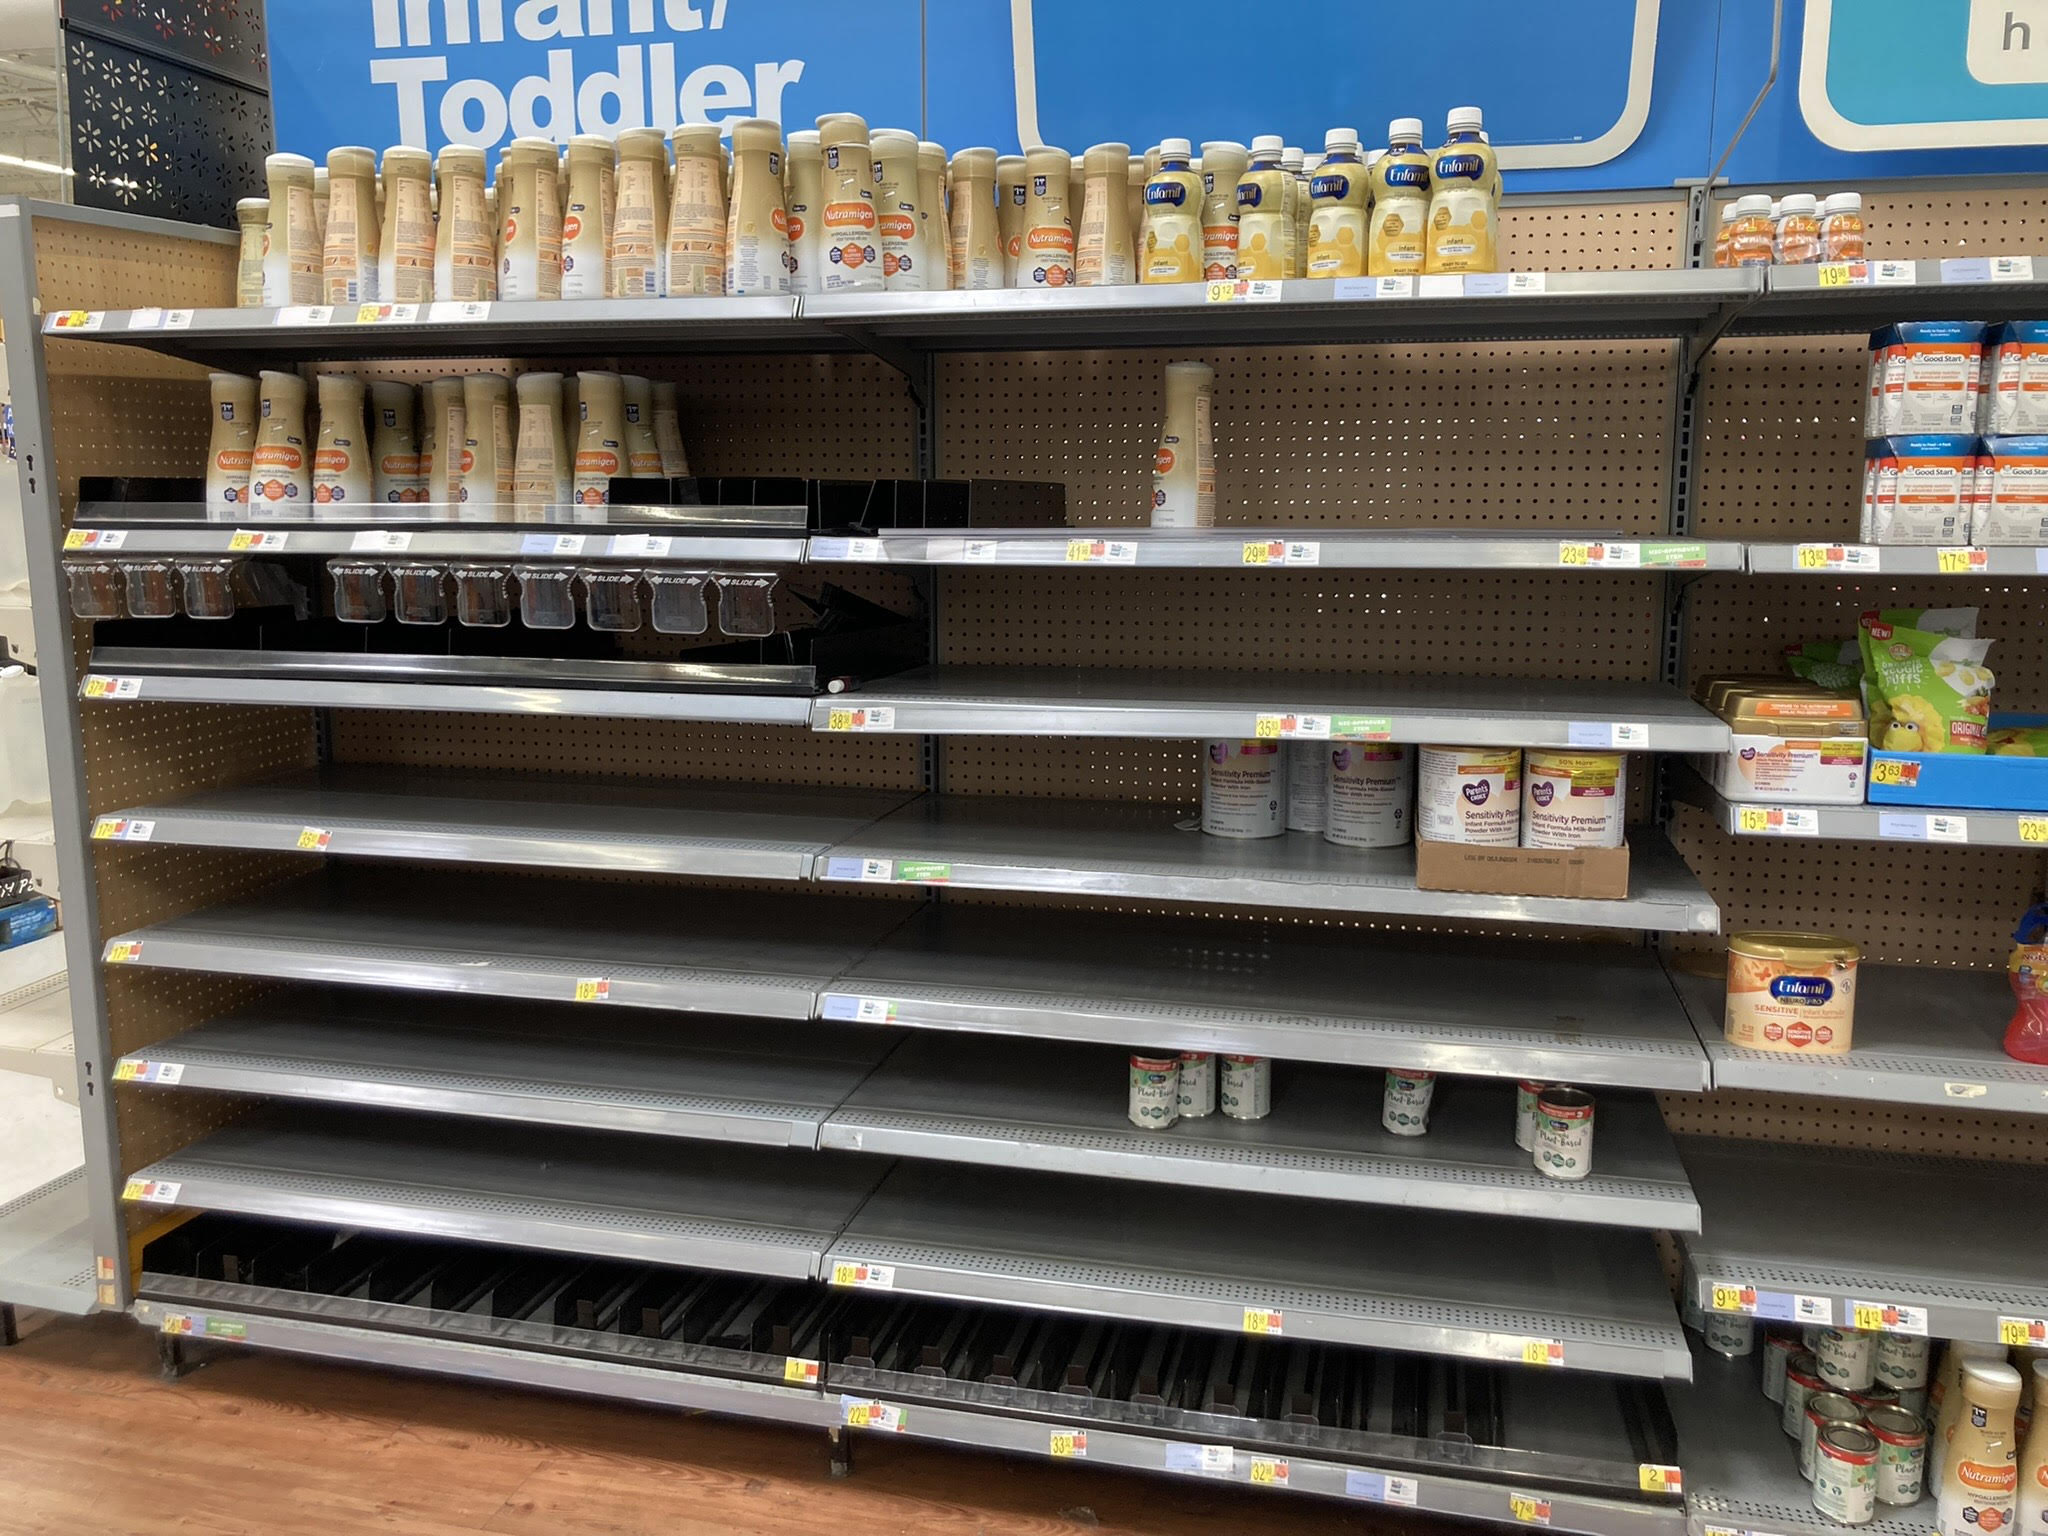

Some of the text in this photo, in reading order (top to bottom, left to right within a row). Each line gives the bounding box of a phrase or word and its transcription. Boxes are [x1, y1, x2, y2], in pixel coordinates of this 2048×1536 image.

[370, 42, 806, 151] Toddler
[1438, 159, 1479, 173] Enfamil
[1311, 179, 1343, 194] Enfamil
[1147, 187, 1182, 200] Enfamil
[825, 208, 874, 222] Nutramigen
[1923, 355, 1943, 363] Good
[1944, 354, 1962, 363] Start
[219, 454, 252, 466] Nutram
[1914, 468, 1953, 476] Good Start
[2012, 468, 2048, 476] Good Star
[190, 565, 211, 573] SLIDE
[343, 567, 363, 575] SLIDE
[404, 568, 426, 576] SLIDE
[531, 573, 554, 581] SLIDE
[597, 575, 621, 583] SLIDE
[663, 577, 688, 585] SLIDE
[731, 578, 756, 586] SLIDE
[1871, 627, 1892, 638] NEW!
[1951, 721, 1982, 736] ORIGINAL
[1756, 751, 1787, 760] Sensitivity
[1558, 758, 1574, 766] 50%
[1211, 768, 1242, 778] Sensitivity
[1887, 767, 1900, 776] 63
[1333, 774, 1364, 785] Sensitivity
[1465, 784, 1489, 797] Parent's
[1465, 810, 1504, 820] Sensitivity
[1532, 810, 1568, 825] Sensitivity
[1547, 824, 1571, 832] Formula
[1552, 830, 1567, 838] With
[1779, 979, 1825, 995] Enfamil
[1754, 1004, 1799, 1015] SENSITIVE
[1539, 1130, 1583, 1148] Plant-Based
[1649, 1469, 1658, 1482] 2
